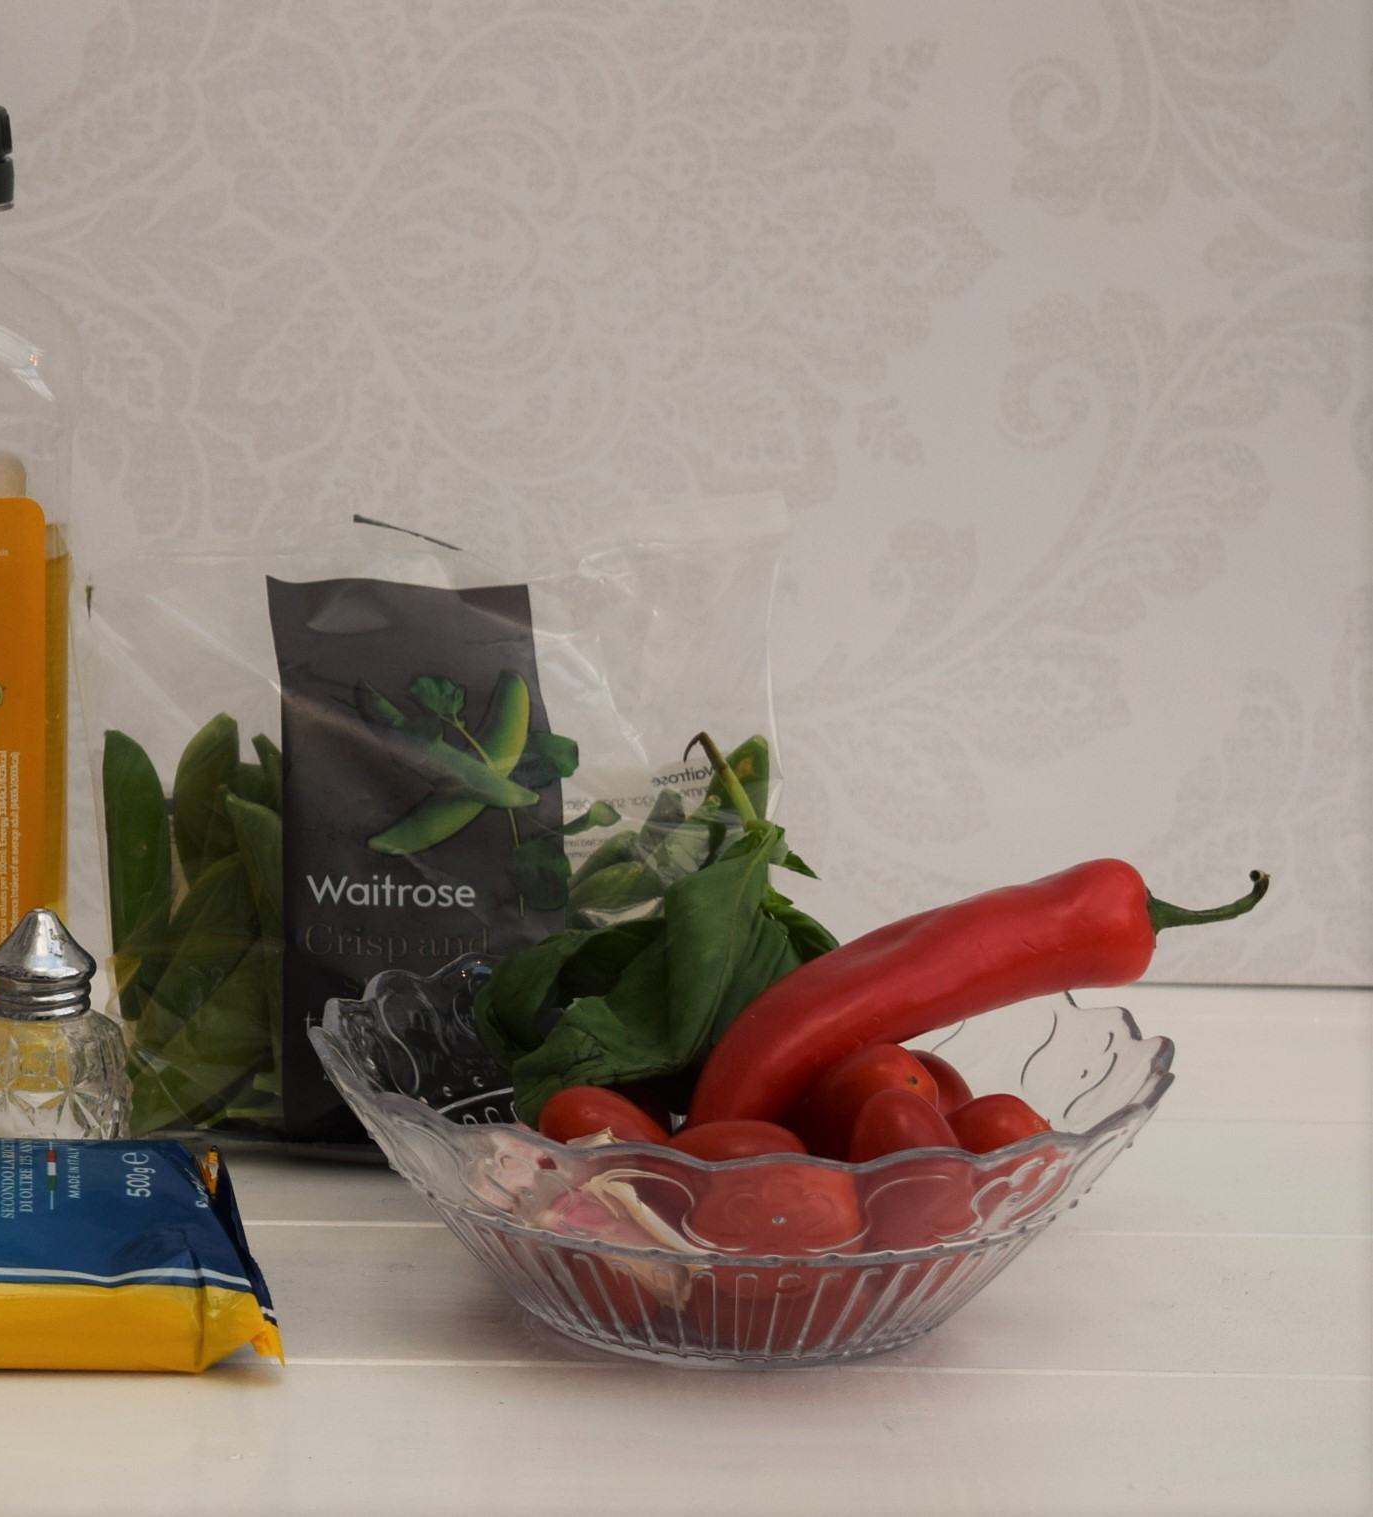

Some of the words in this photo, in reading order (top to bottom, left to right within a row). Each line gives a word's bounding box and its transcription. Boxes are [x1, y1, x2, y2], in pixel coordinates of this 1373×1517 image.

[306, 874, 476, 908] Waitrose
[305, 923, 408, 963] Crisp
[419, 928, 488, 956] and
[1, 1160, 15, 1170] LA
[68, 1148, 80, 1166] ITALY
[0, 1171, 15, 1219] SECONDO
[19, 1168, 34, 1200] OLTRE
[68, 1175, 80, 1199] MADE
[126, 1167, 156, 1198] 500g
[19, 1200, 34, 1212] DI
